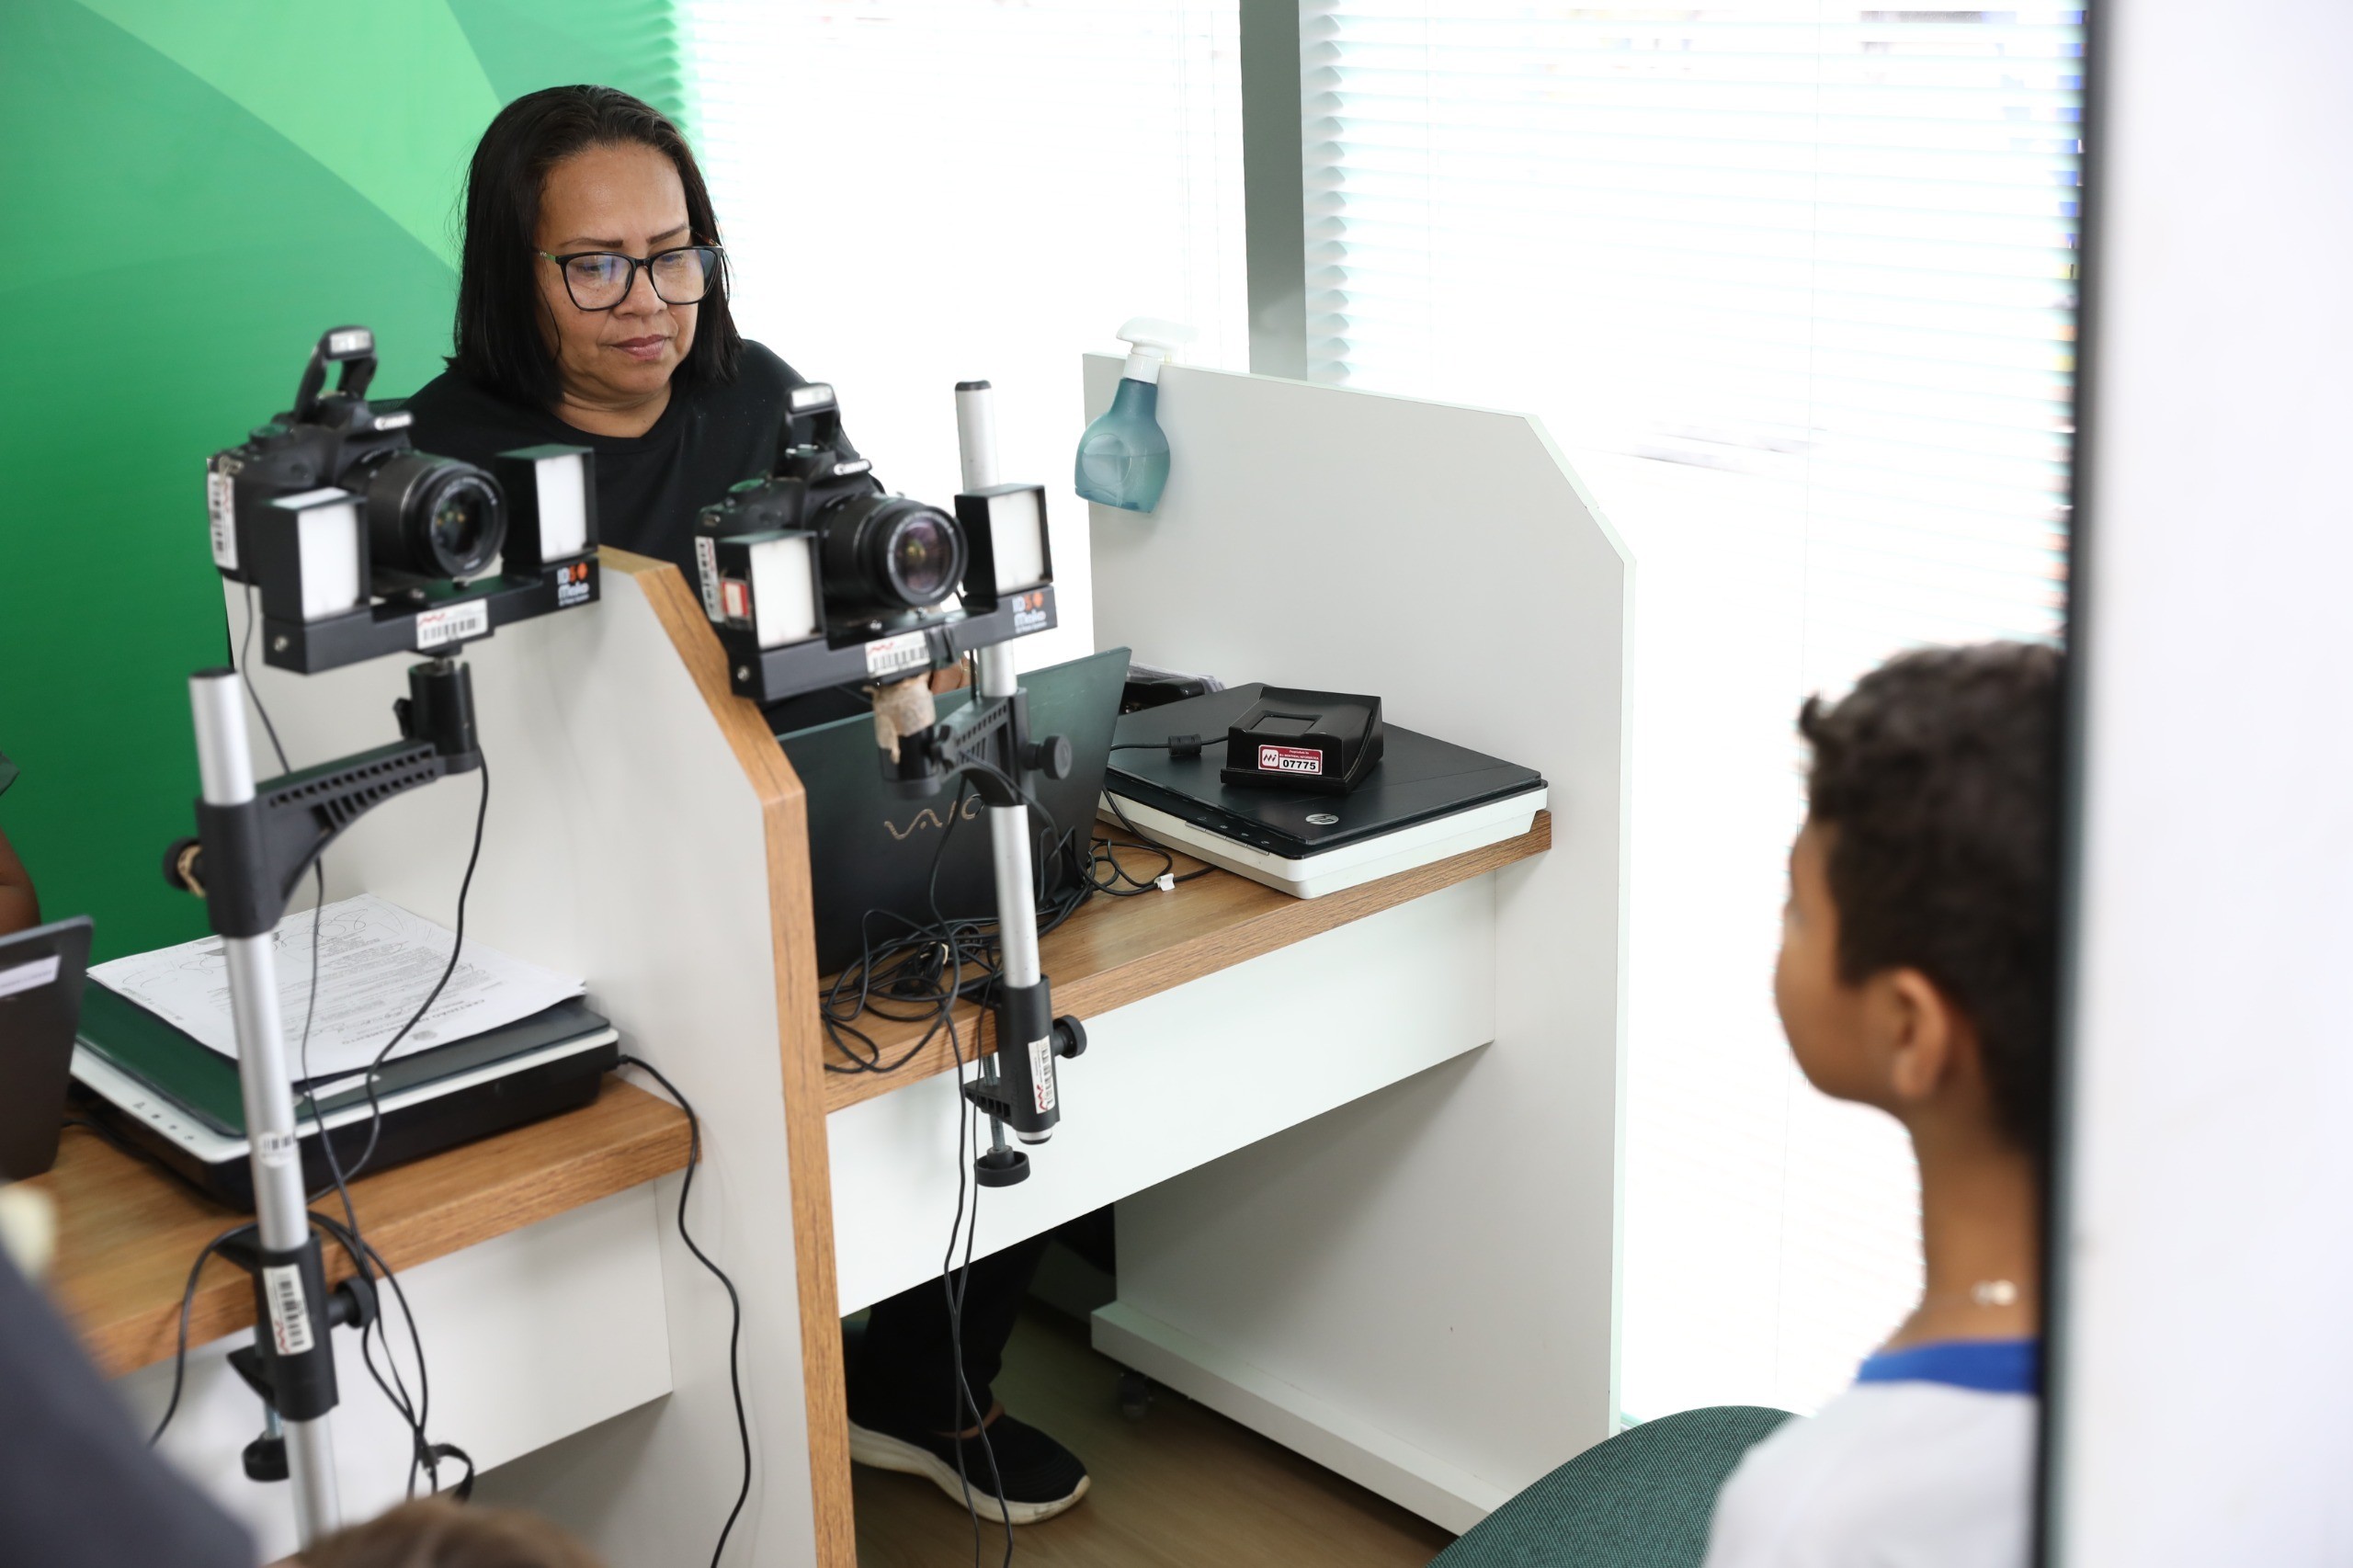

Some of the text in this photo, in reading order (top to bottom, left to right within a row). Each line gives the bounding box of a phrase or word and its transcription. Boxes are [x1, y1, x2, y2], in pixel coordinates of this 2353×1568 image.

[374, 415, 413, 431] Canon
[833, 460, 870, 476] Canon
[1282, 759, 1316, 770] 07775
[883, 793, 985, 840] VAIO
